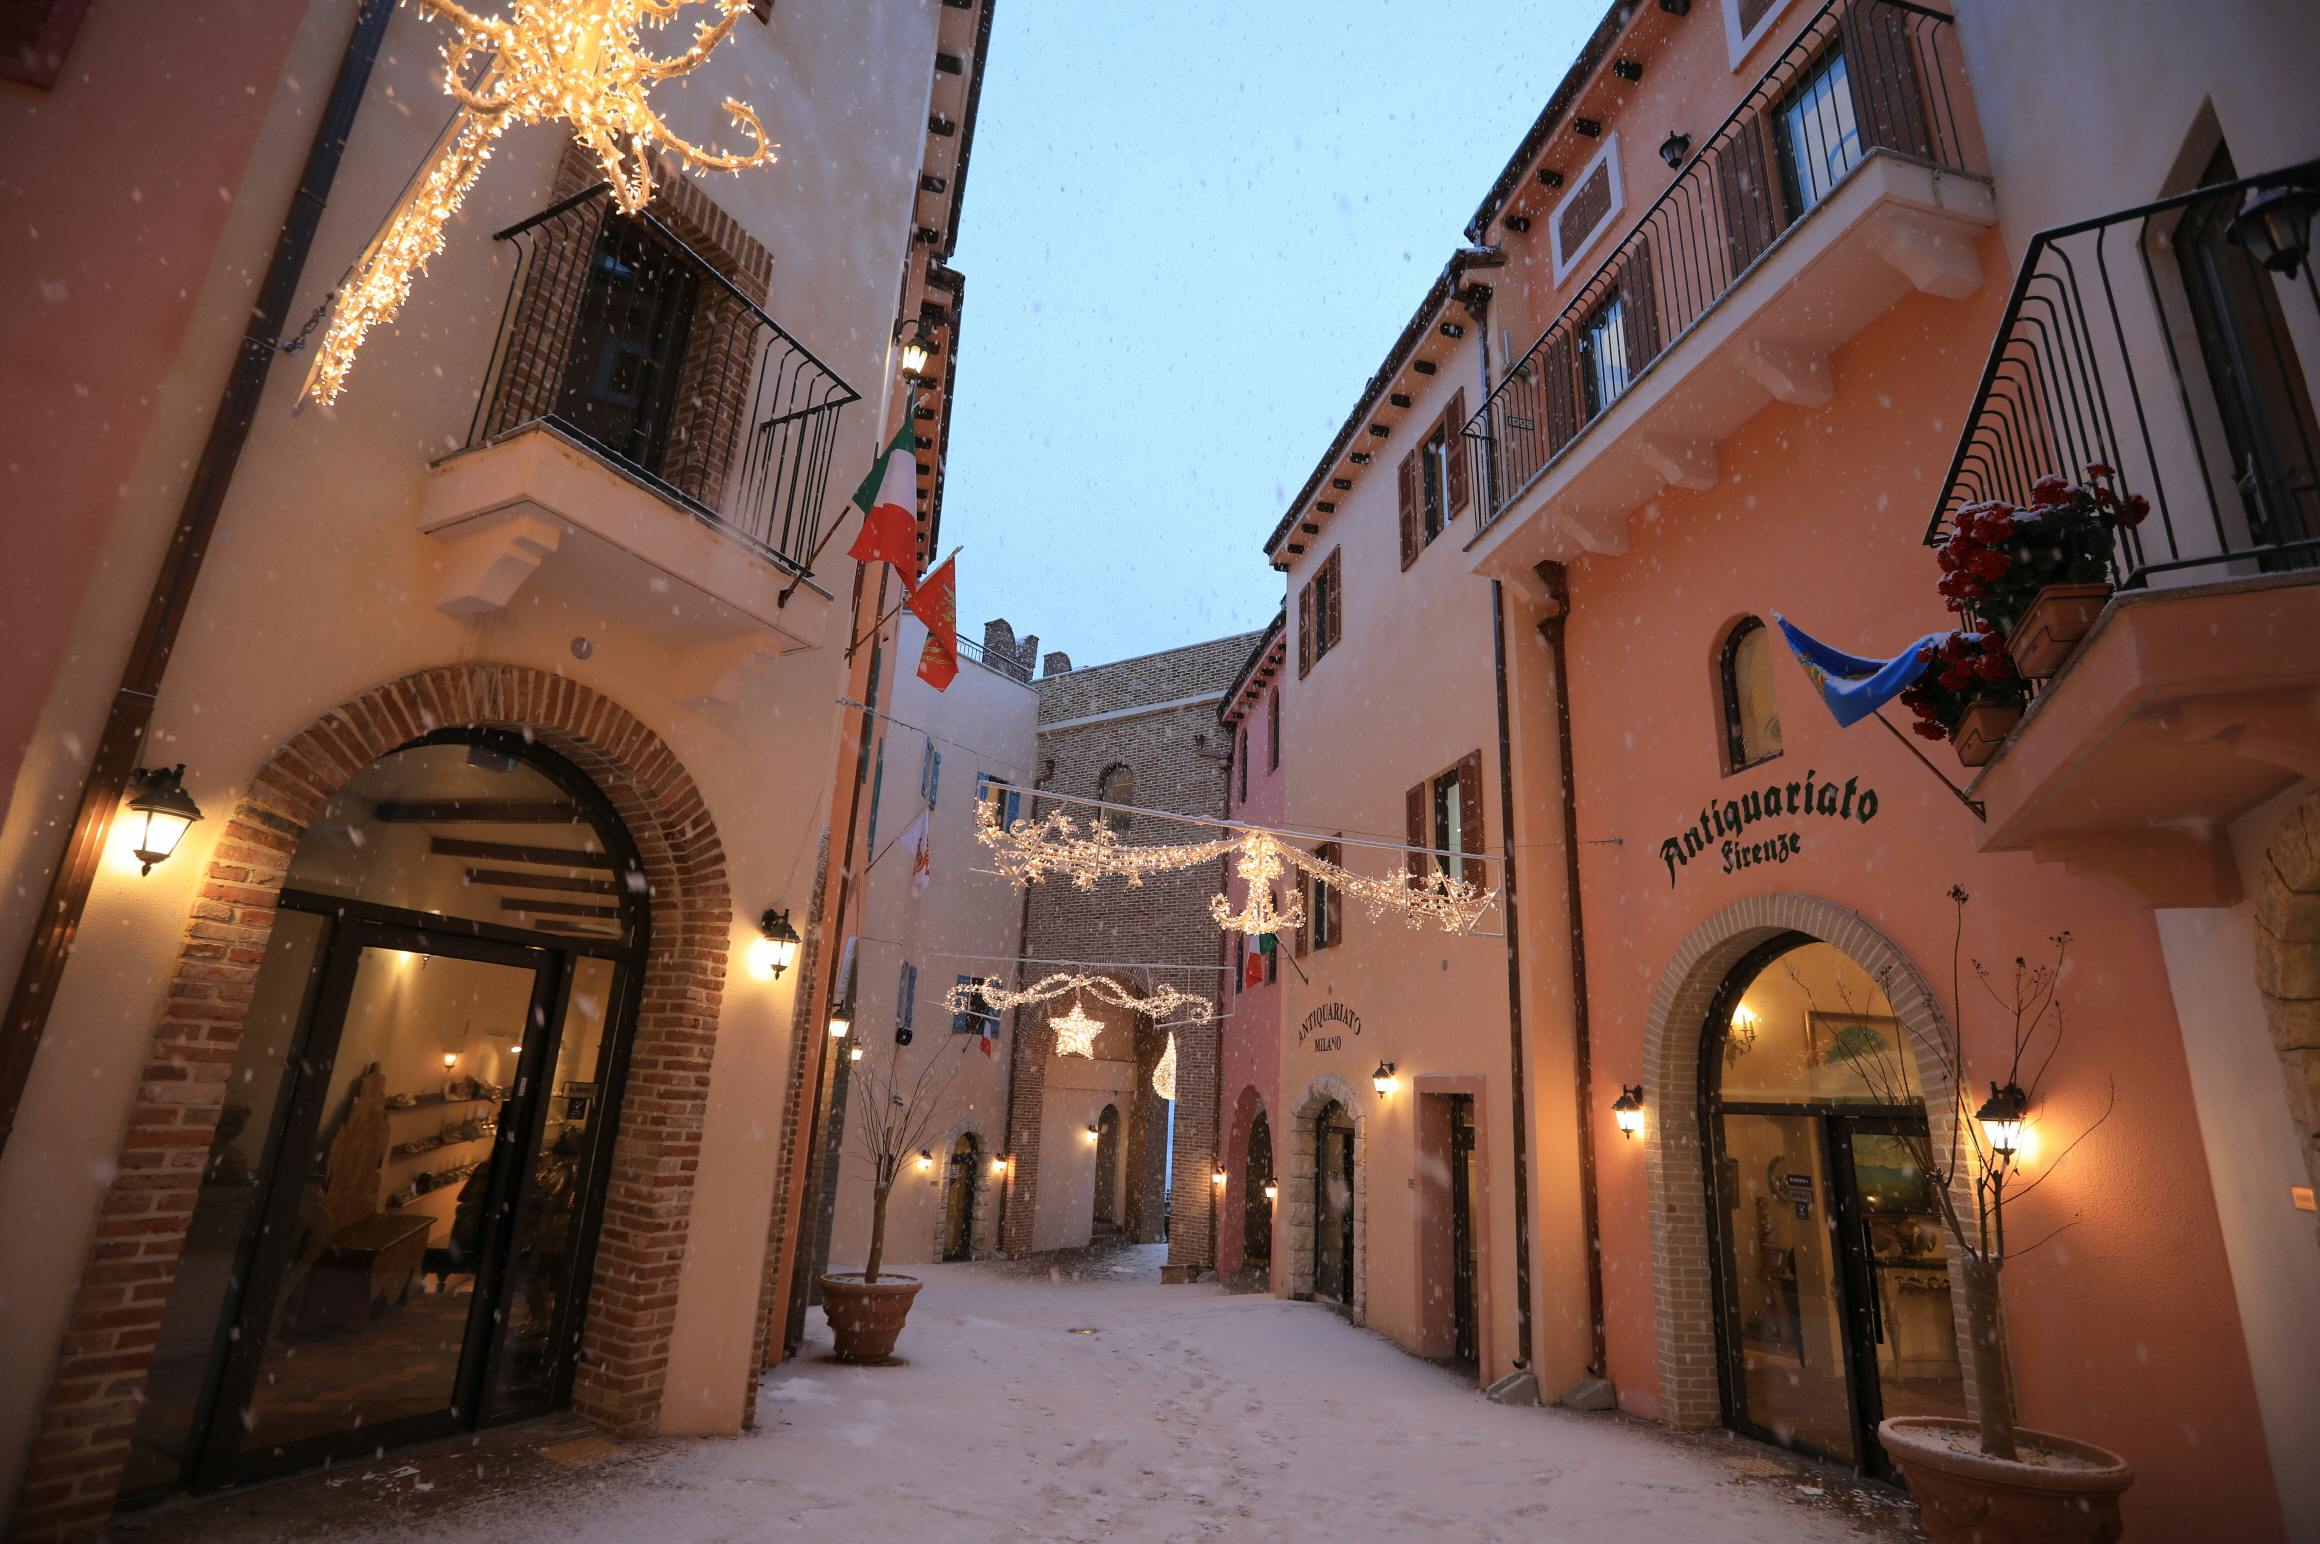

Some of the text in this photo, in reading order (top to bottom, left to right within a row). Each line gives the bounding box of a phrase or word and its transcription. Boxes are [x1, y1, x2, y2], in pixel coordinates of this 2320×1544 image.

[1659, 769, 1879, 890] Antiquariato
[1720, 831, 1802, 875] Firenze
[1298, 1002, 1361, 1047] ANTIQUARIATO
[1314, 1036, 1342, 1052] MILANO
